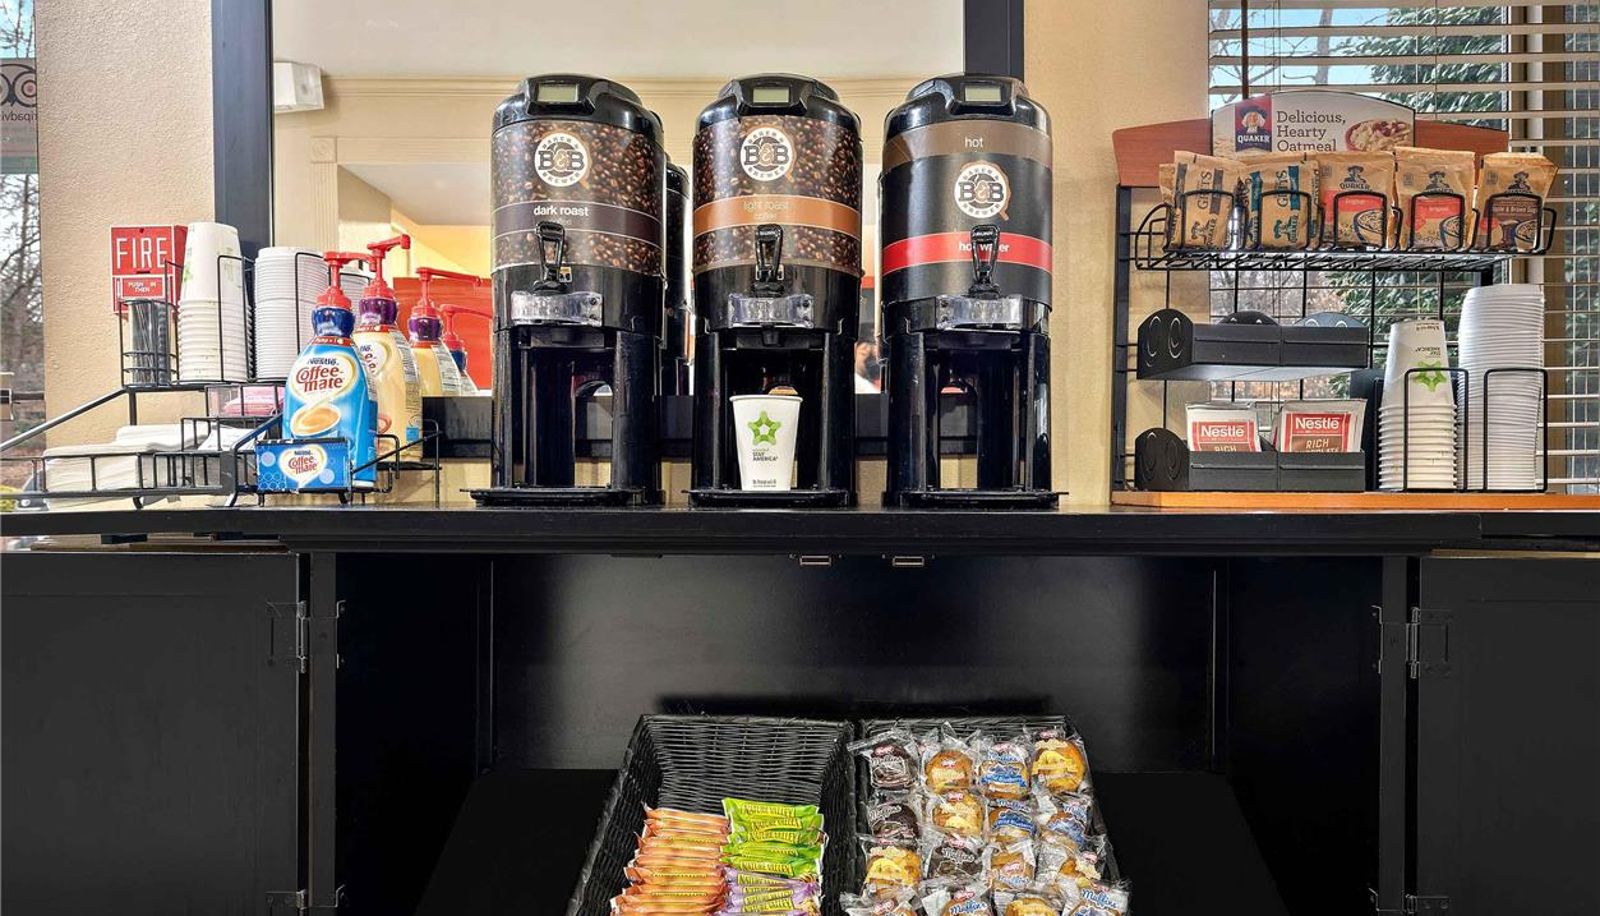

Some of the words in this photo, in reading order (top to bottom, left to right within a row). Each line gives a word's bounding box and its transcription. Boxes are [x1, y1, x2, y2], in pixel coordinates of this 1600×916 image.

[1277, 109, 1346, 125] Delicious,
[1237, 134, 1270, 143] QUAKER
[1277, 125, 1327, 140] Hearty
[964, 136, 984, 148] hot
[1277, 139, 1337, 152] Oatmeal
[533, 205, 558, 216] dark
[560, 207, 590, 217] roast
[116, 237, 168, 269] FIRE
[304, 377, 343, 392] mate
[1305, 438, 1329, 449] RICH
